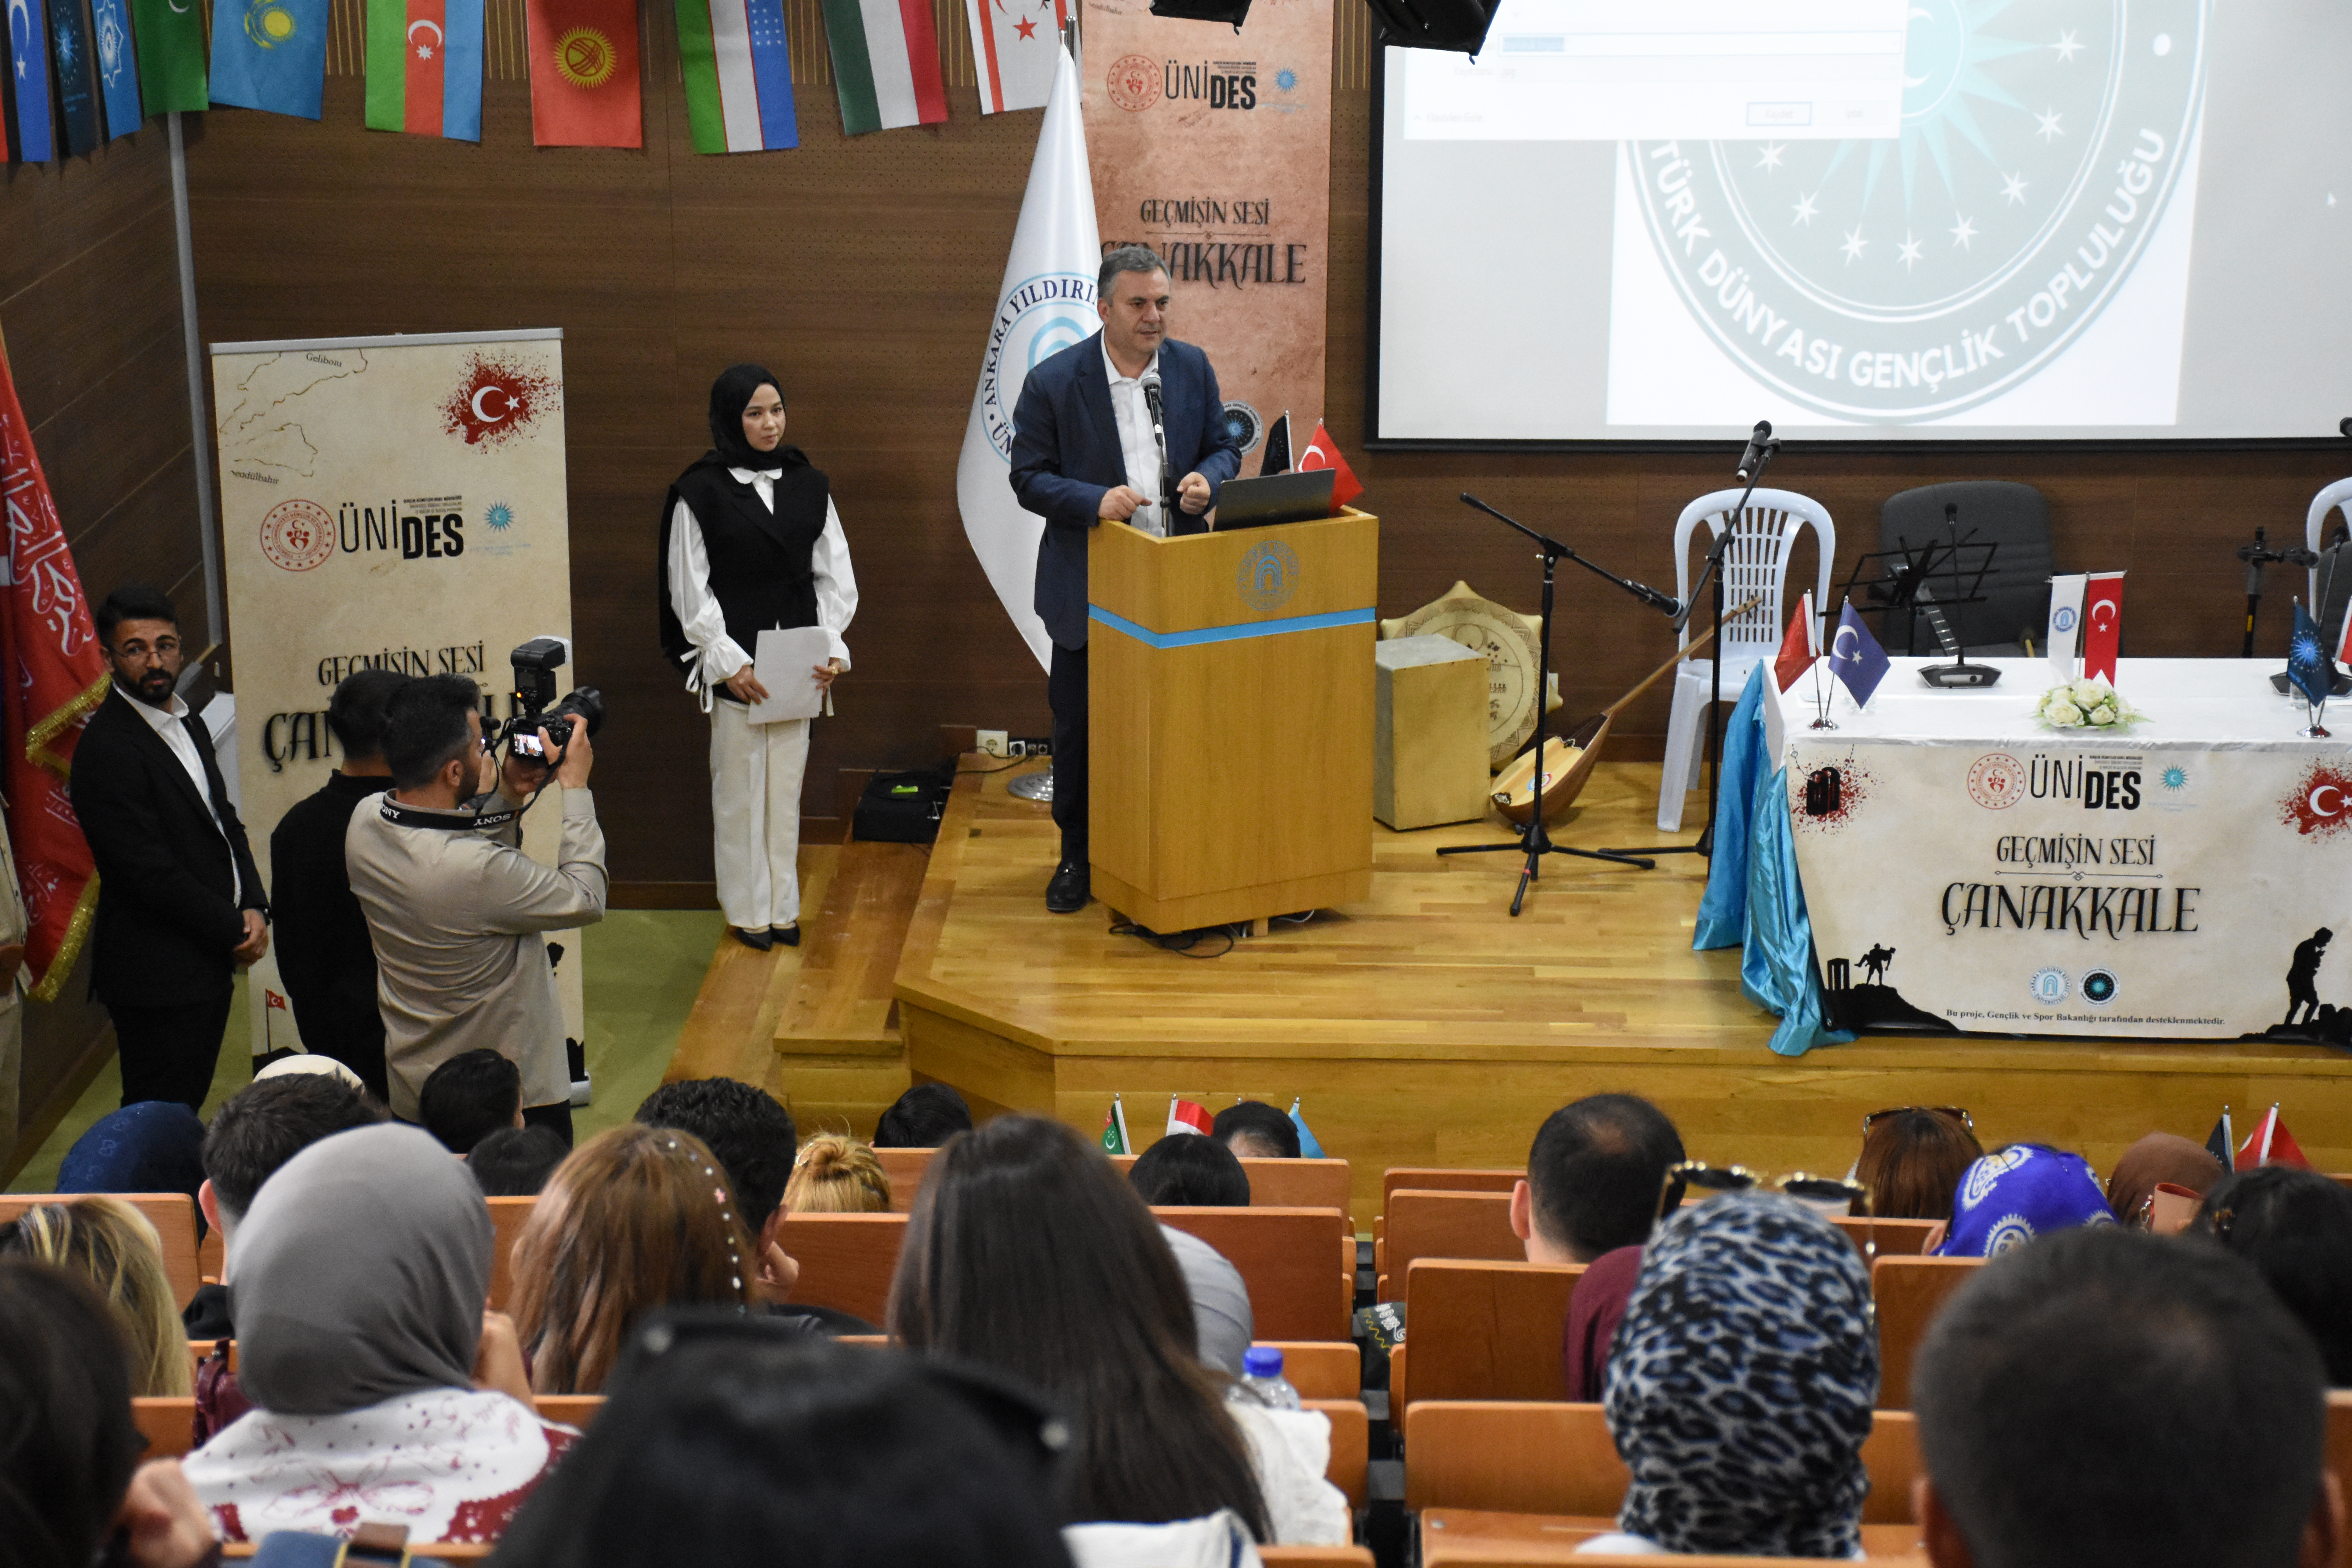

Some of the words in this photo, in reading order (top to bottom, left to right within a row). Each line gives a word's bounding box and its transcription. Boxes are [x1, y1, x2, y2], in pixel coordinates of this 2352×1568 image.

[1165, 59, 1256, 110] ÜNİDES
[1140, 196, 1228, 228] GEÇMİŞİN
[1233, 198, 1269, 225] SESİ
[1650, 140, 1711, 258] TÜRK
[1697, 248, 1844, 380] DÜNYASI
[1849, 324, 2005, 394] GENÇLİK
[2005, 127, 2165, 343] TOPLULUĞU
[985, 316, 1011, 405] ANKARA
[1009, 279, 1097, 315] YILDIRI
[339, 499, 465, 560] ÜNİDES
[438, 640, 484, 674] SESİ
[2030, 754, 2142, 810] ÜNİDES
[381, 805, 400, 819] ONY
[473, 813, 511, 826] SONY
[1996, 833, 2103, 869] GEÇMİŞİN
[2110, 835, 2156, 866] SESİ
[1941, 882, 2201, 940] ÇANAKKALE
[1960, 1011, 1985, 1019] proje,
[1987, 1011, 2020, 1020] Gençlik
[2034, 1013, 2054, 1022] Spor
[2057, 1013, 2096, 1023] Bakanlığı
[2146, 1016, 2225, 1024] desteklenmektedir.
